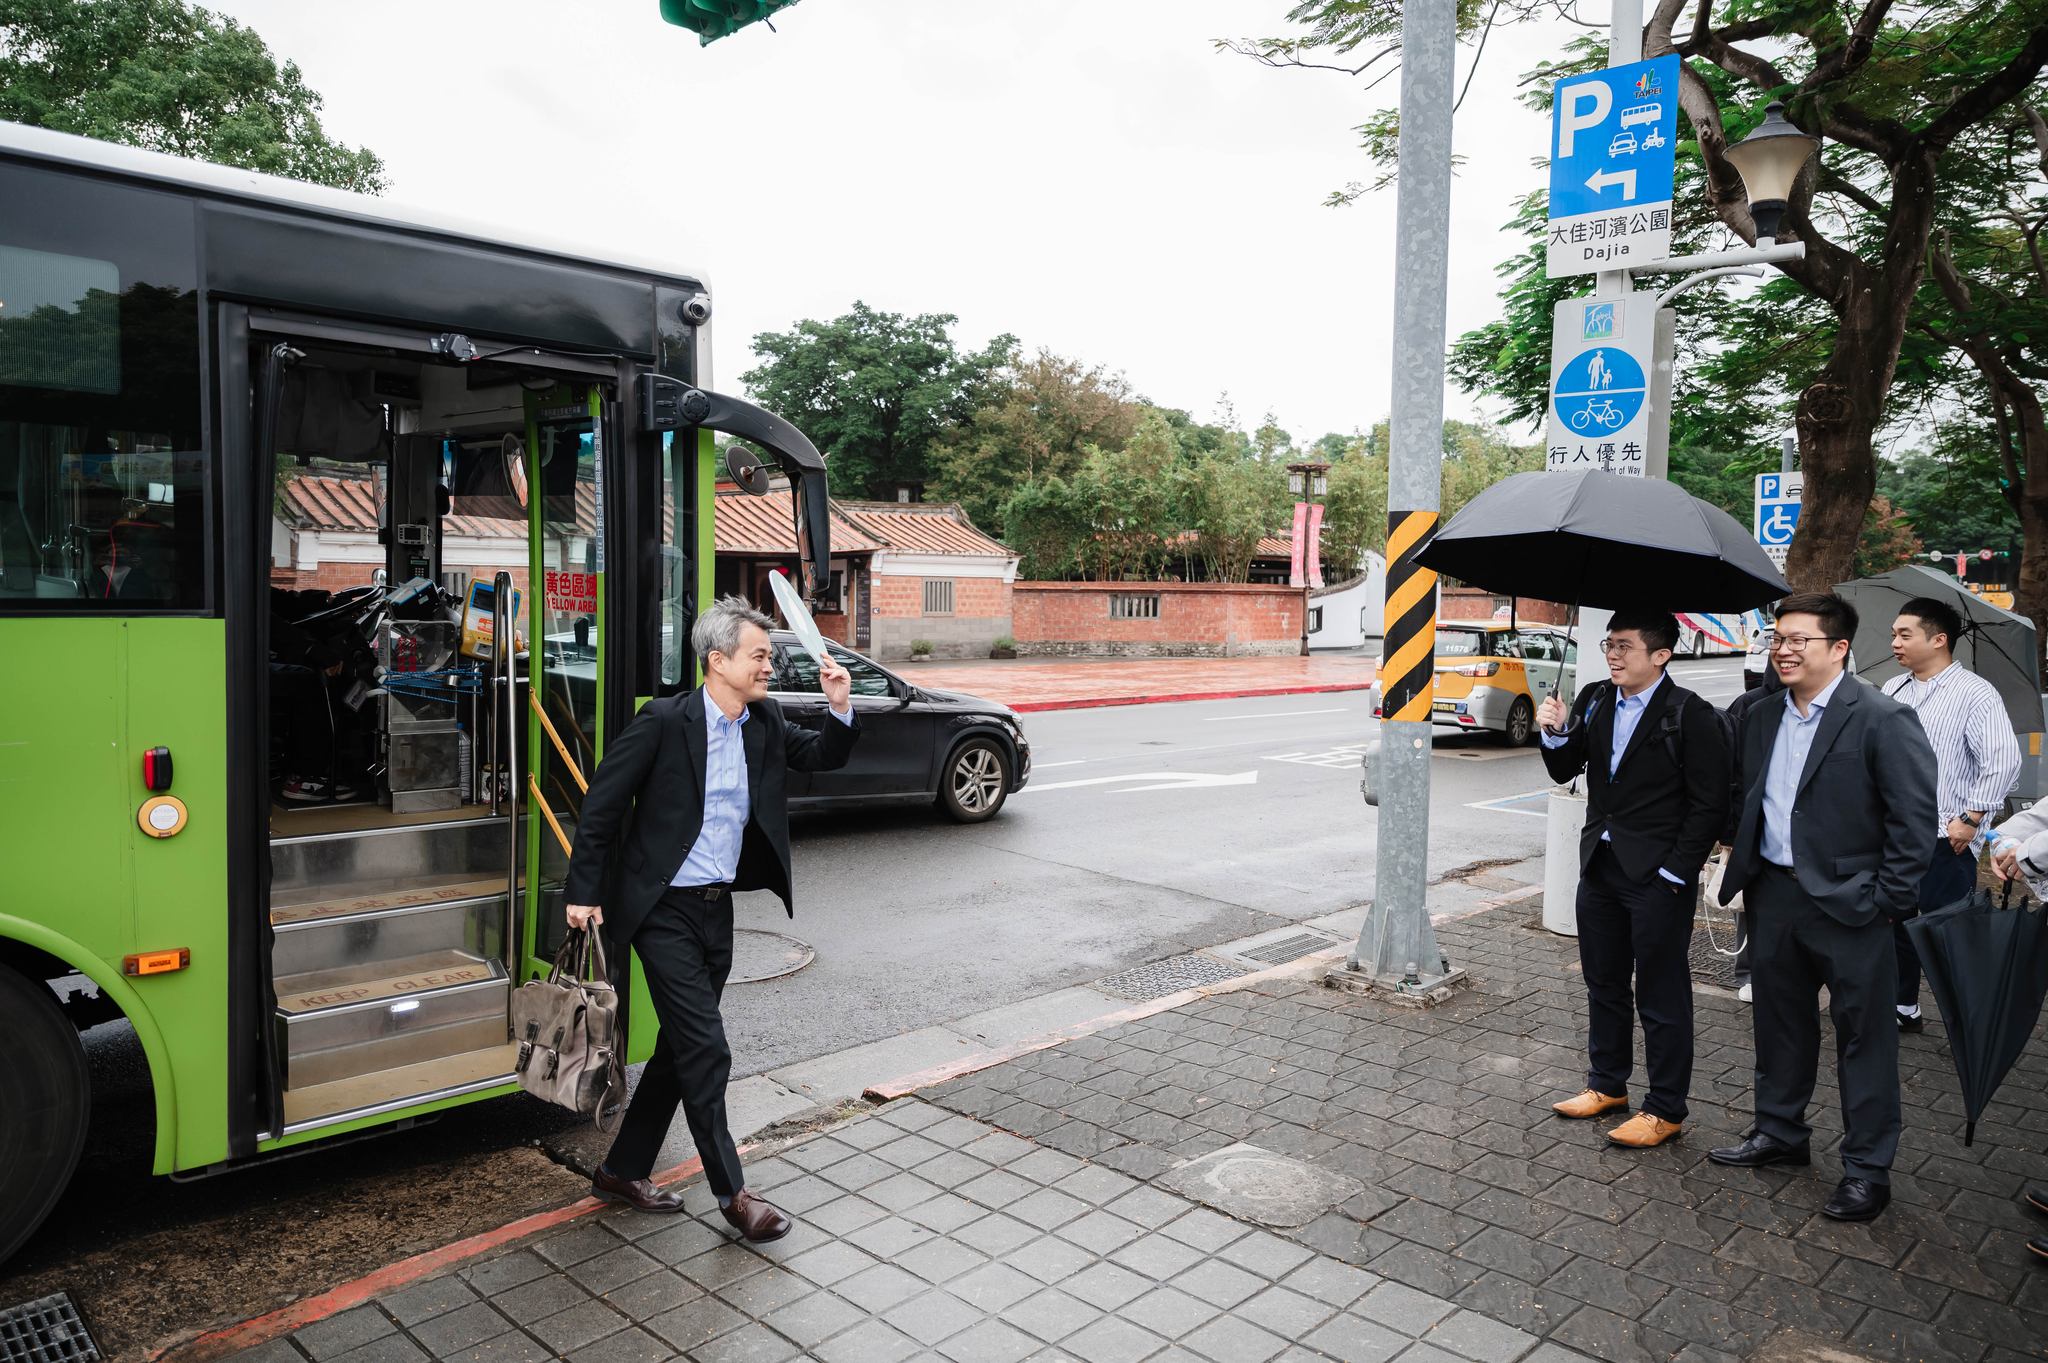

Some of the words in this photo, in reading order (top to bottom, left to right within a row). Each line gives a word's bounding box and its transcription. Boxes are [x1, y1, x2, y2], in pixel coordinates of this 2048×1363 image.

[1634, 87, 1662, 99] TAIPEI
[1558, 80, 1613, 159] P
[1550, 208, 1669, 246] 大佳河濱公園
[1583, 243, 1630, 261] Dajia
[1549, 441, 1642, 464] 行人優先
[1627, 465, 1641, 476] Way
[1763, 478, 1777, 496] P
[546, 597, 576, 612] YELLOW
[577, 599, 597, 613] AREA
[300, 988, 370, 1007] KEEP
[392, 969, 476, 990] CLEAR
